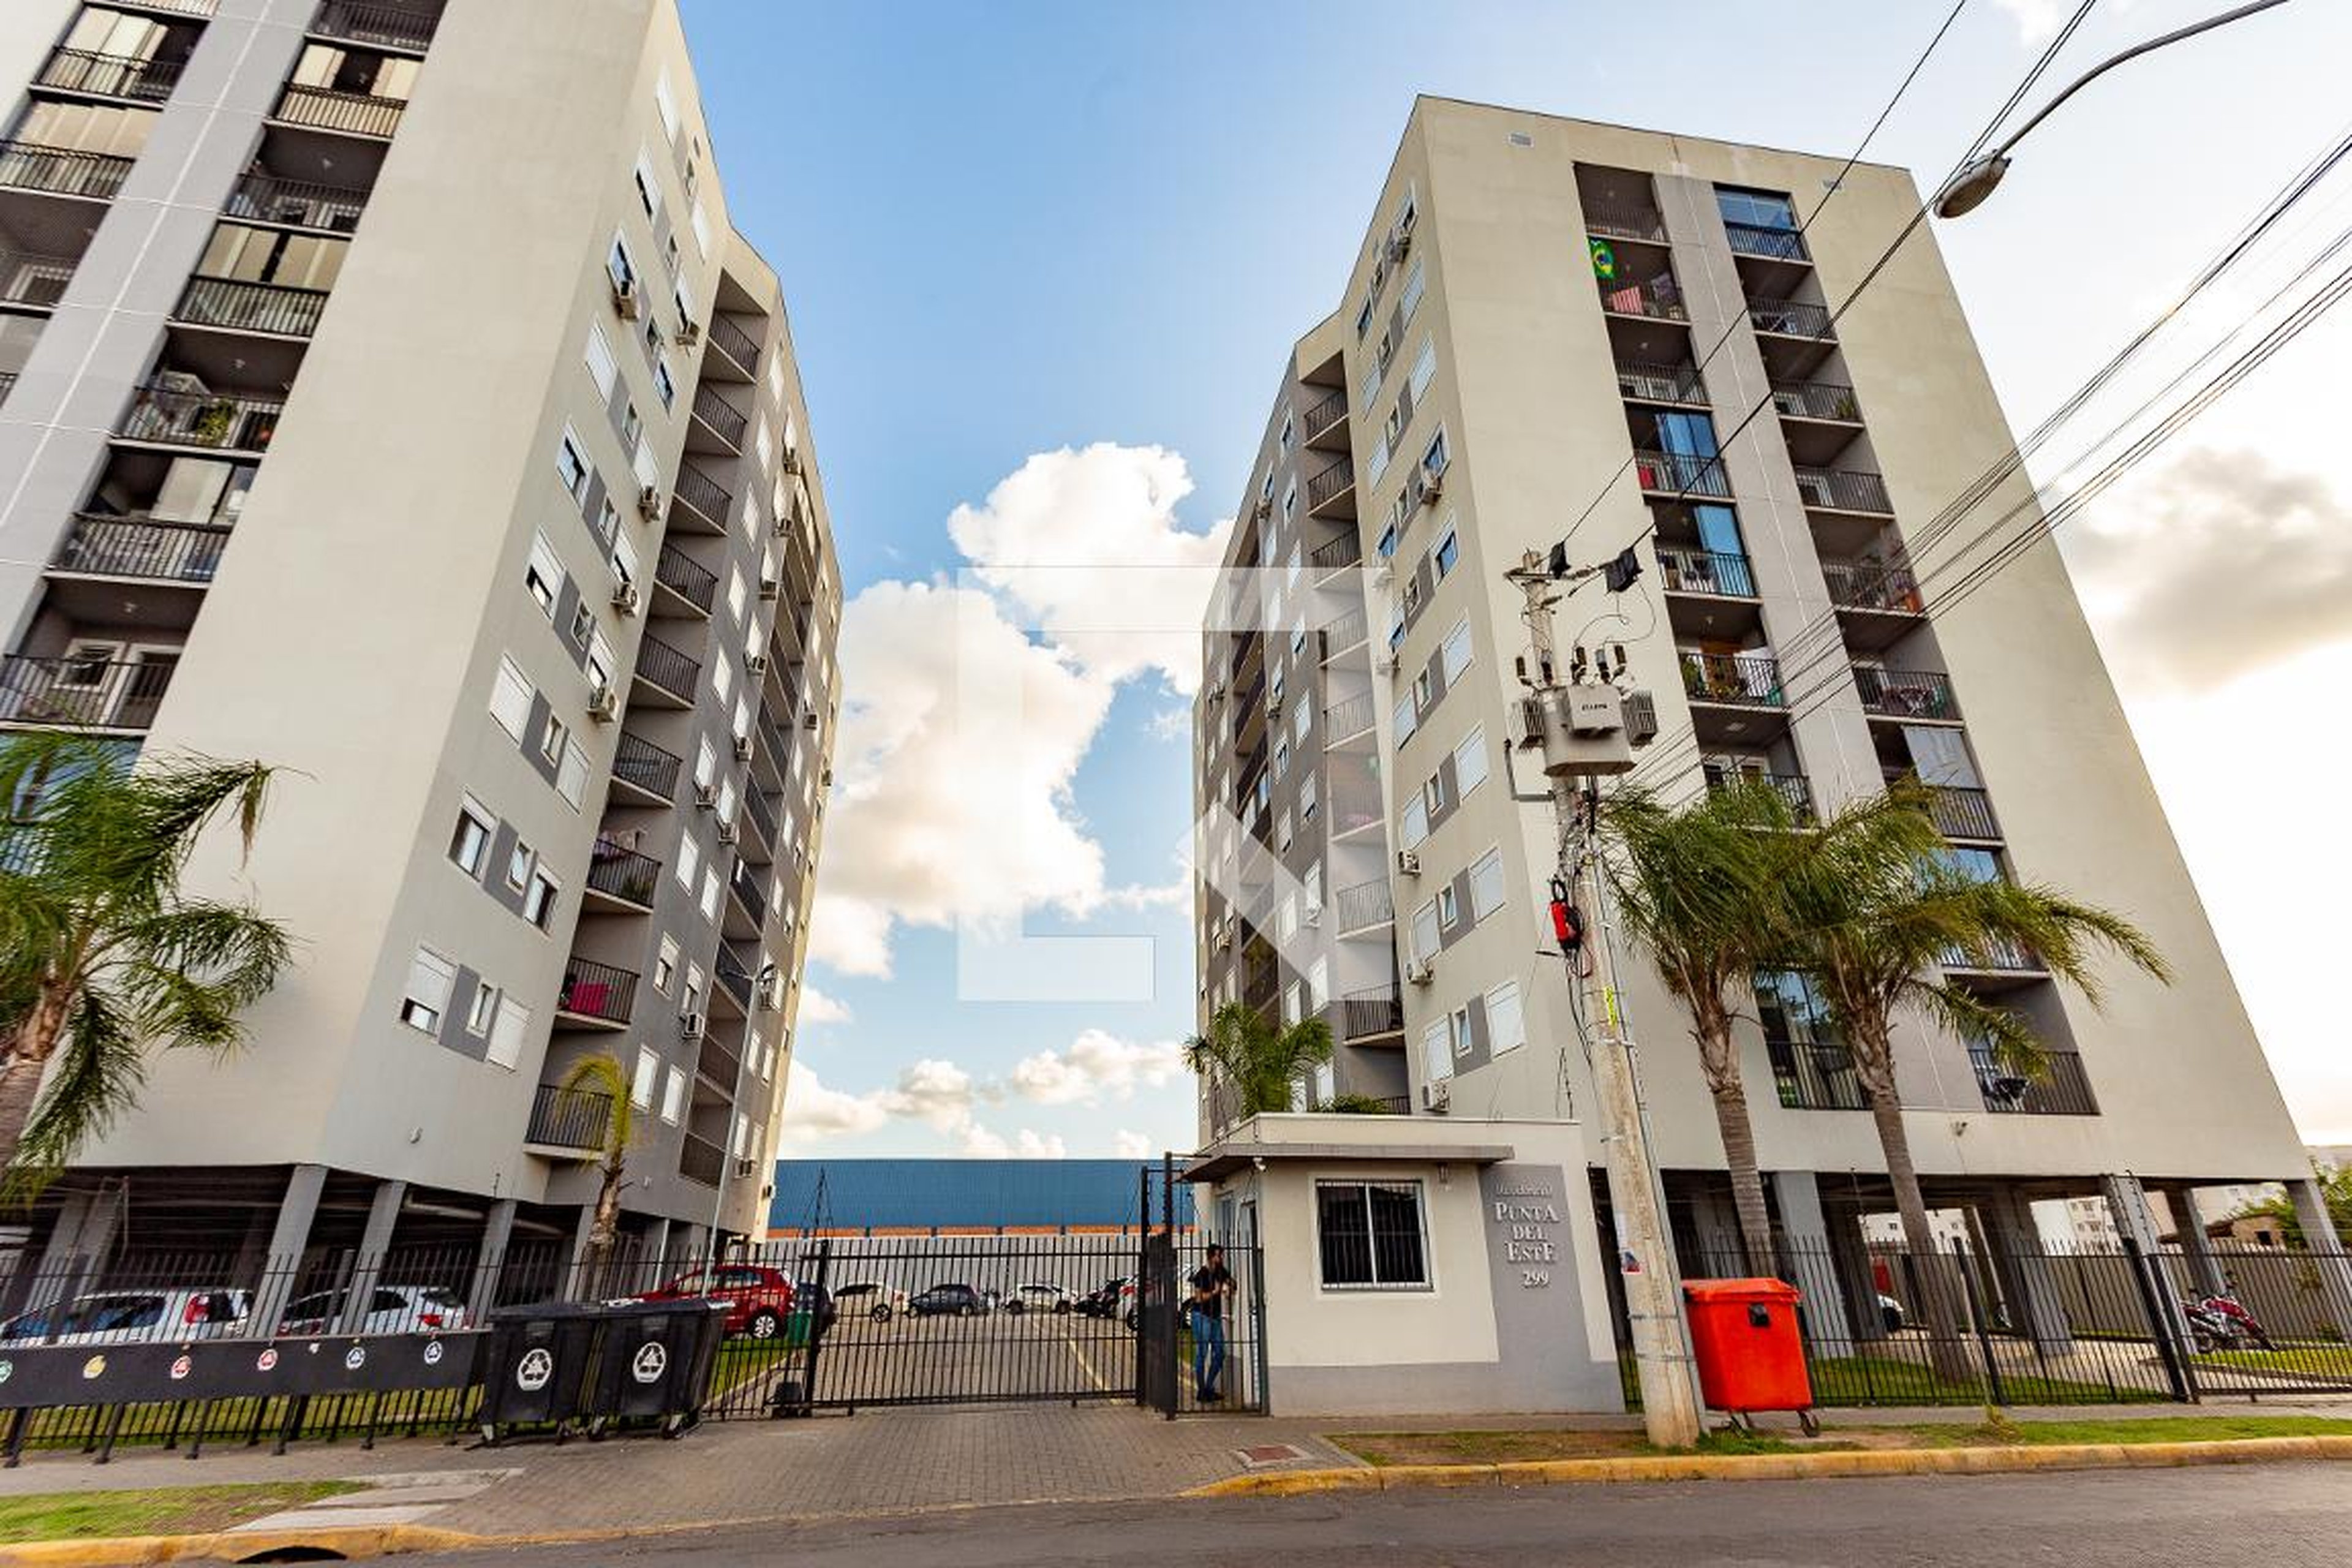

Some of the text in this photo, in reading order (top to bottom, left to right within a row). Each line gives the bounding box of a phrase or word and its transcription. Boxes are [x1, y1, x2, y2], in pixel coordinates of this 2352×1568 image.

[1494, 1202, 1559, 1223] PUNTA
[1512, 1225, 1548, 1240] DEL
[1504, 1242, 1556, 1262] ESTE
[1523, 1270, 1549, 1286] 299
